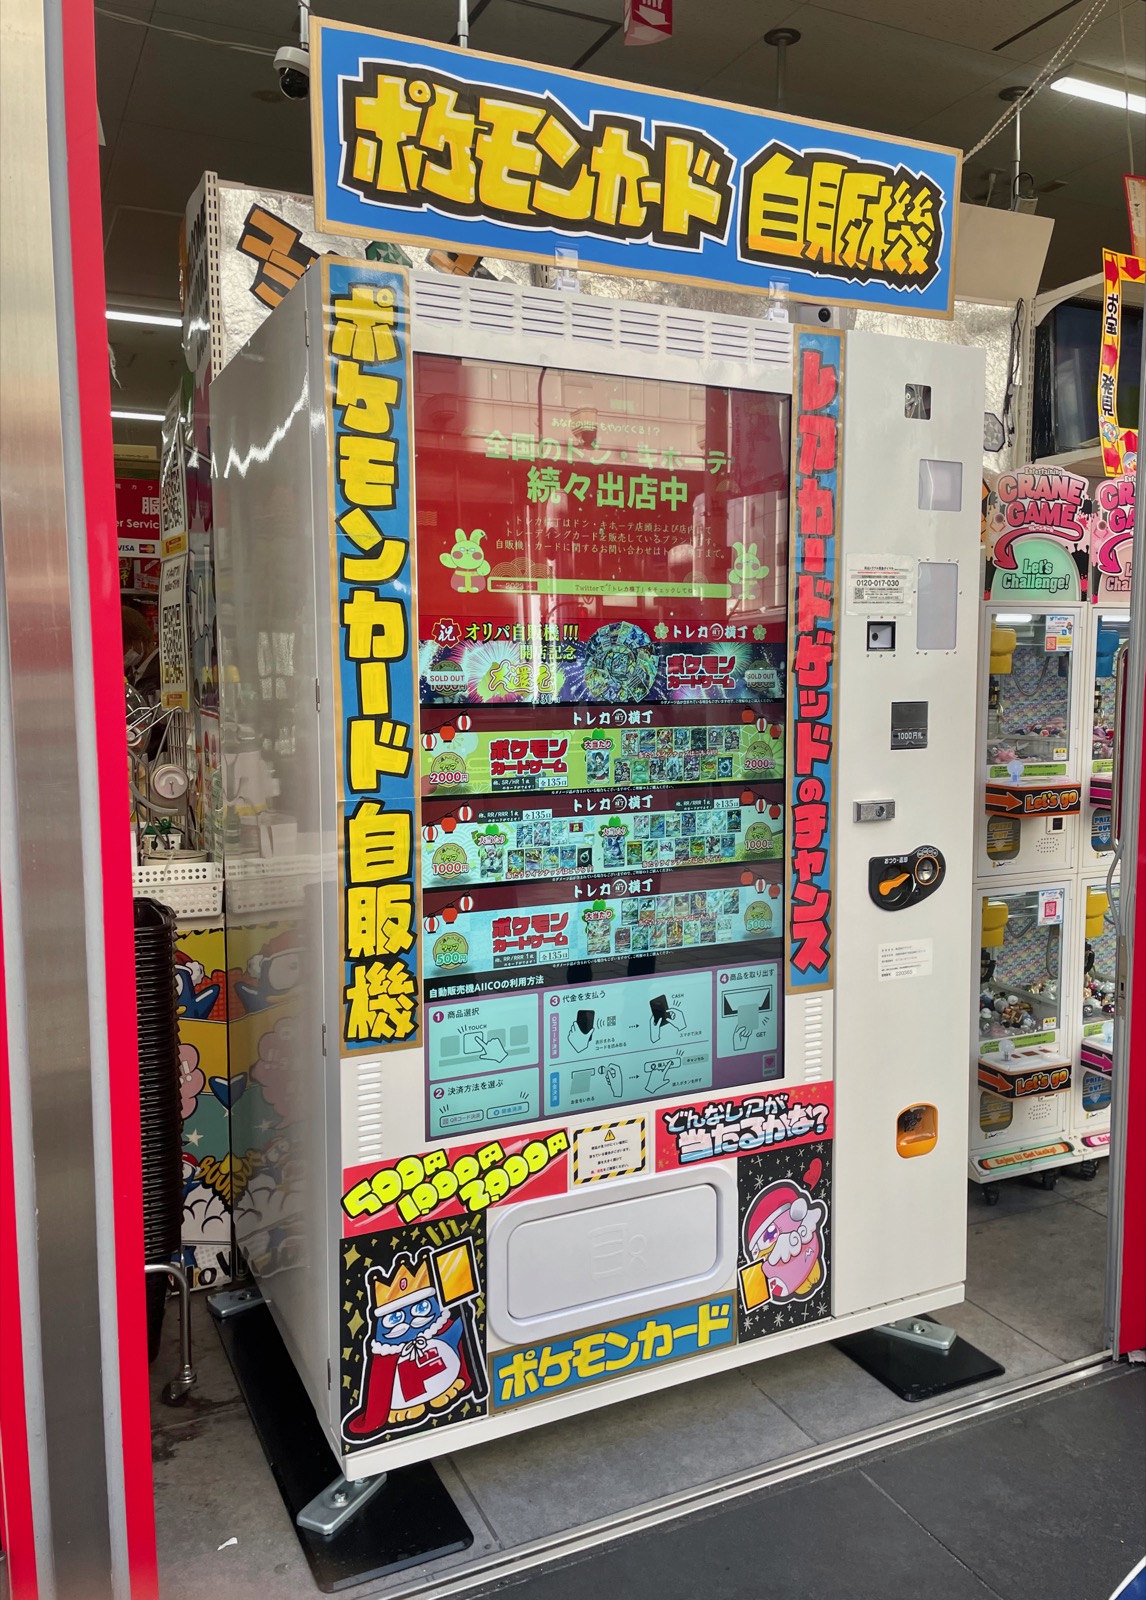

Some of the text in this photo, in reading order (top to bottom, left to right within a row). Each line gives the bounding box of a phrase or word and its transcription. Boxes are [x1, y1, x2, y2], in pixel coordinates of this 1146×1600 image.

[350, 68, 940, 281] ポケモンカード 自販機
[1100, 294, 1119, 417] お宝 発見
[526, 466, 688, 512] 続々出店中
[998, 473, 1085, 505] CRANE
[1006, 502, 1077, 527] GAME
[1022, 558, 1053, 575] Let's
[856, 579, 900, 587] 0120-017-030
[1002, 573, 1070, 594] Challenge!
[438, 624, 456, 642] 祝
[673, 625, 749, 639] トレカ 横丁
[667, 654, 737, 675] ポケモン
[667, 675, 737, 690] カードゲーム
[573, 710, 654, 726] トレカ 横丁
[490, 739, 568, 760] ポケモン
[584, 740, 613, 749] 大当たり
[491, 759, 568, 776] カードゲーム
[430, 772, 469, 784] 2000円
[573, 794, 654, 811] トレカ 横丁
[1025, 790, 1078, 812] Let's go
[432, 863, 469, 875] 1000円
[574, 879, 654, 898] トレカ 横丁
[492, 912, 569, 938] ポケモン
[584, 911, 613, 921] 大当たり
[493, 933, 569, 953] カードゲーム
[436, 952, 468, 965] 500円
[729, 969, 775, 981] 商品を取り出す
[429, 975, 544, 999] 自動販売機AIICOの利用方法
[562, 990, 606, 1003] 代金を支払う
[447, 1007, 480, 1019] 商品選択
[447, 1079, 504, 1096] 決済方法を選ぶ
[1016, 1069, 1068, 1096] Let's go
[677, 1103, 829, 1164] 当たるかな?
[498, 1303, 730, 1401] ポケモンカード
